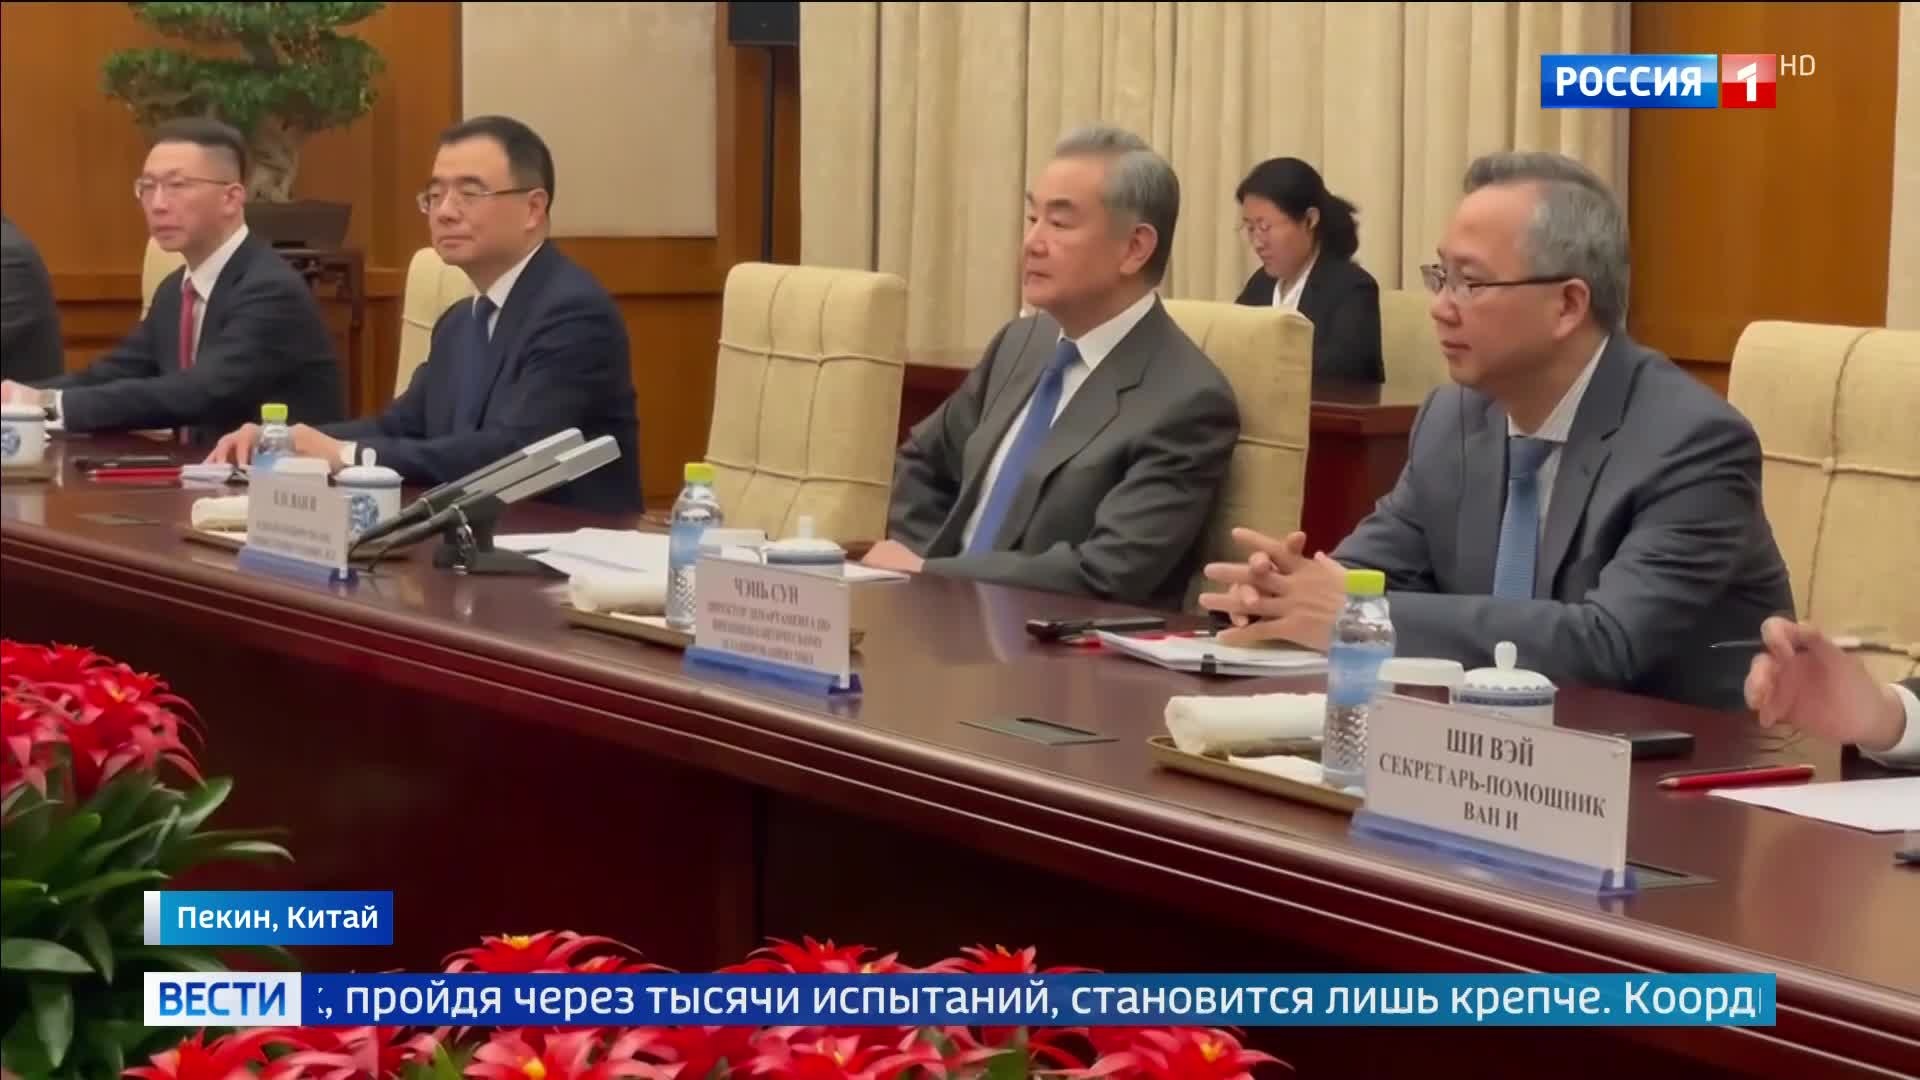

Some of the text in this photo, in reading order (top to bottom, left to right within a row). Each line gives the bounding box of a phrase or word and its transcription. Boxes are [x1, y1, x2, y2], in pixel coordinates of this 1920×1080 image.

[1446, 728, 1535, 768] ШИ ВЭЙ
[1378, 751, 1607, 819] СЕКРЕТАРЬ-ПОМОЩНИК
[1463, 801, 1519, 832] ВАН И
